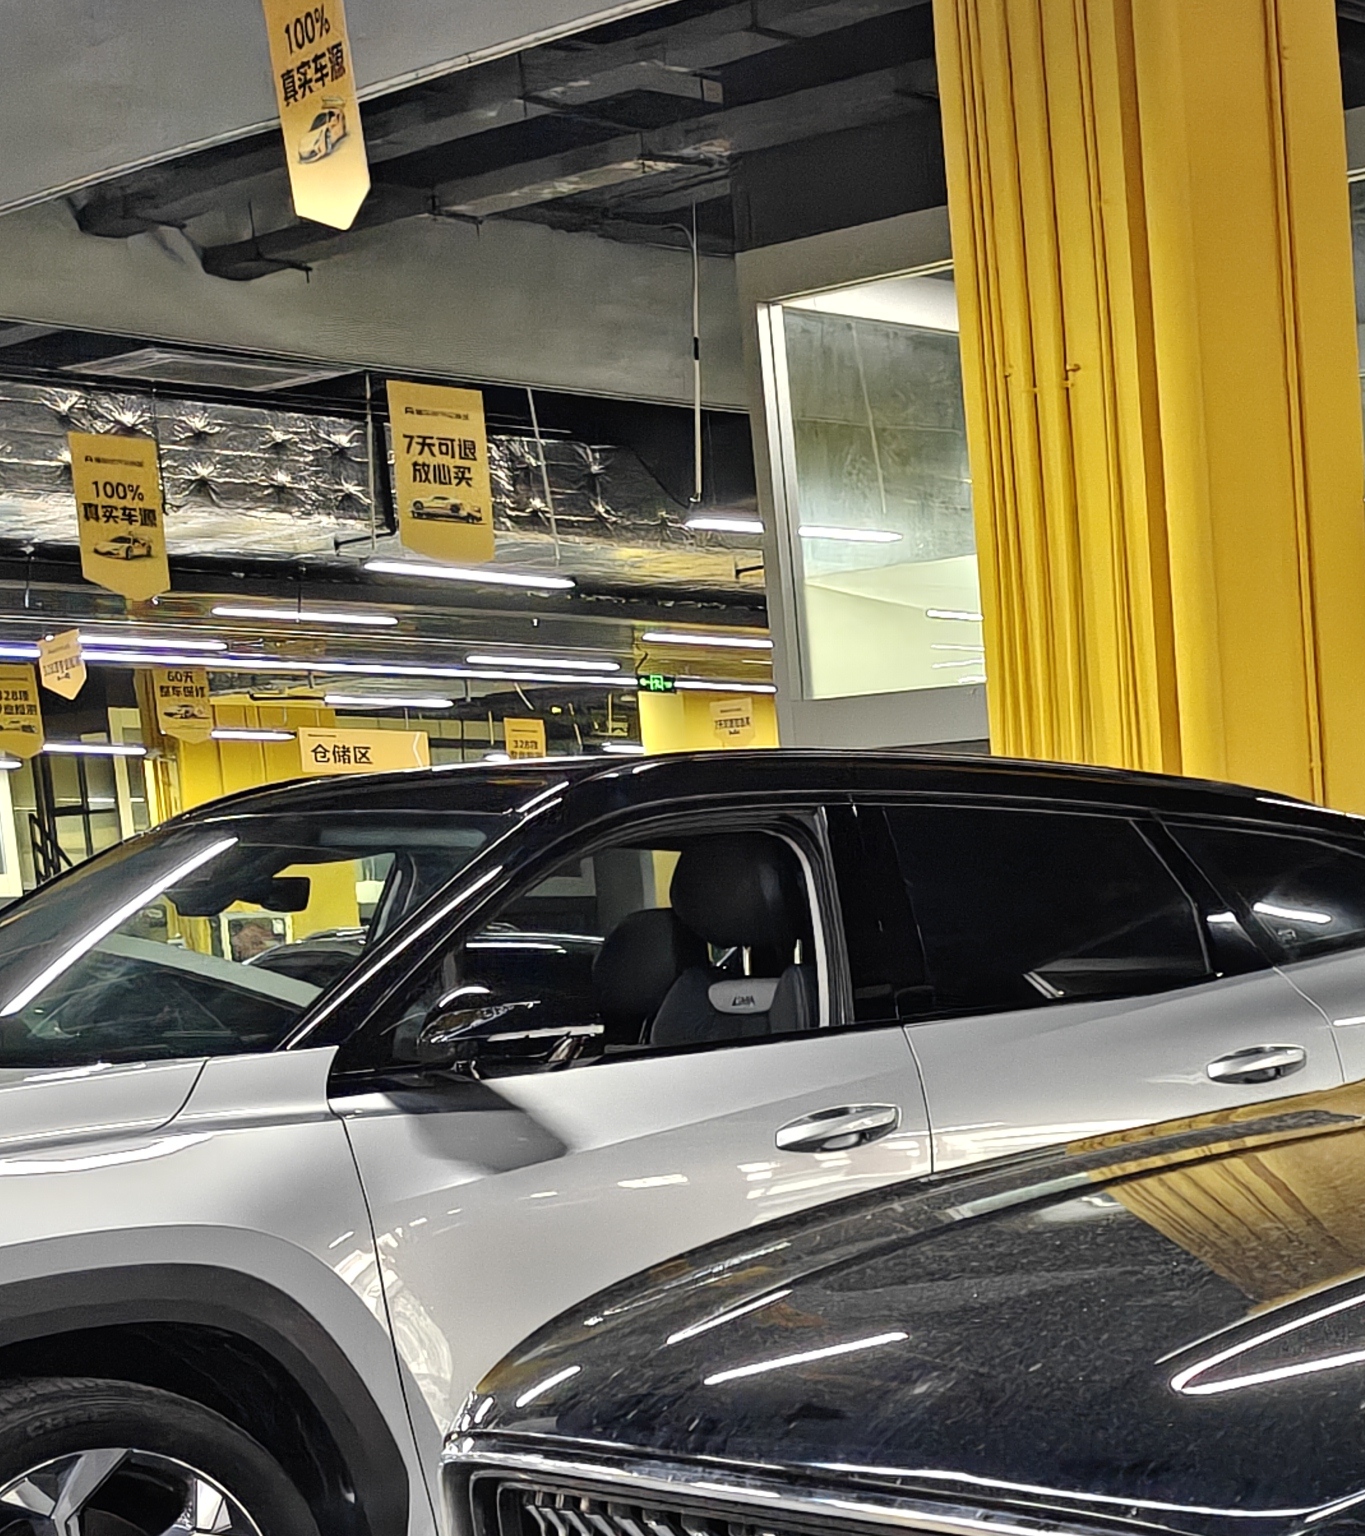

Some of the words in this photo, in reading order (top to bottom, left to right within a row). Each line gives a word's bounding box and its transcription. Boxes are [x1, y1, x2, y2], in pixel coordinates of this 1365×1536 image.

[284, 3, 331, 55] 100%
[281, 41, 346, 107] 真实车源
[402, 433, 478, 462] 7天可退
[412, 460, 474, 488] 放心买
[92, 481, 144, 502] 100%
[310, 743, 374, 765] 仓储区
